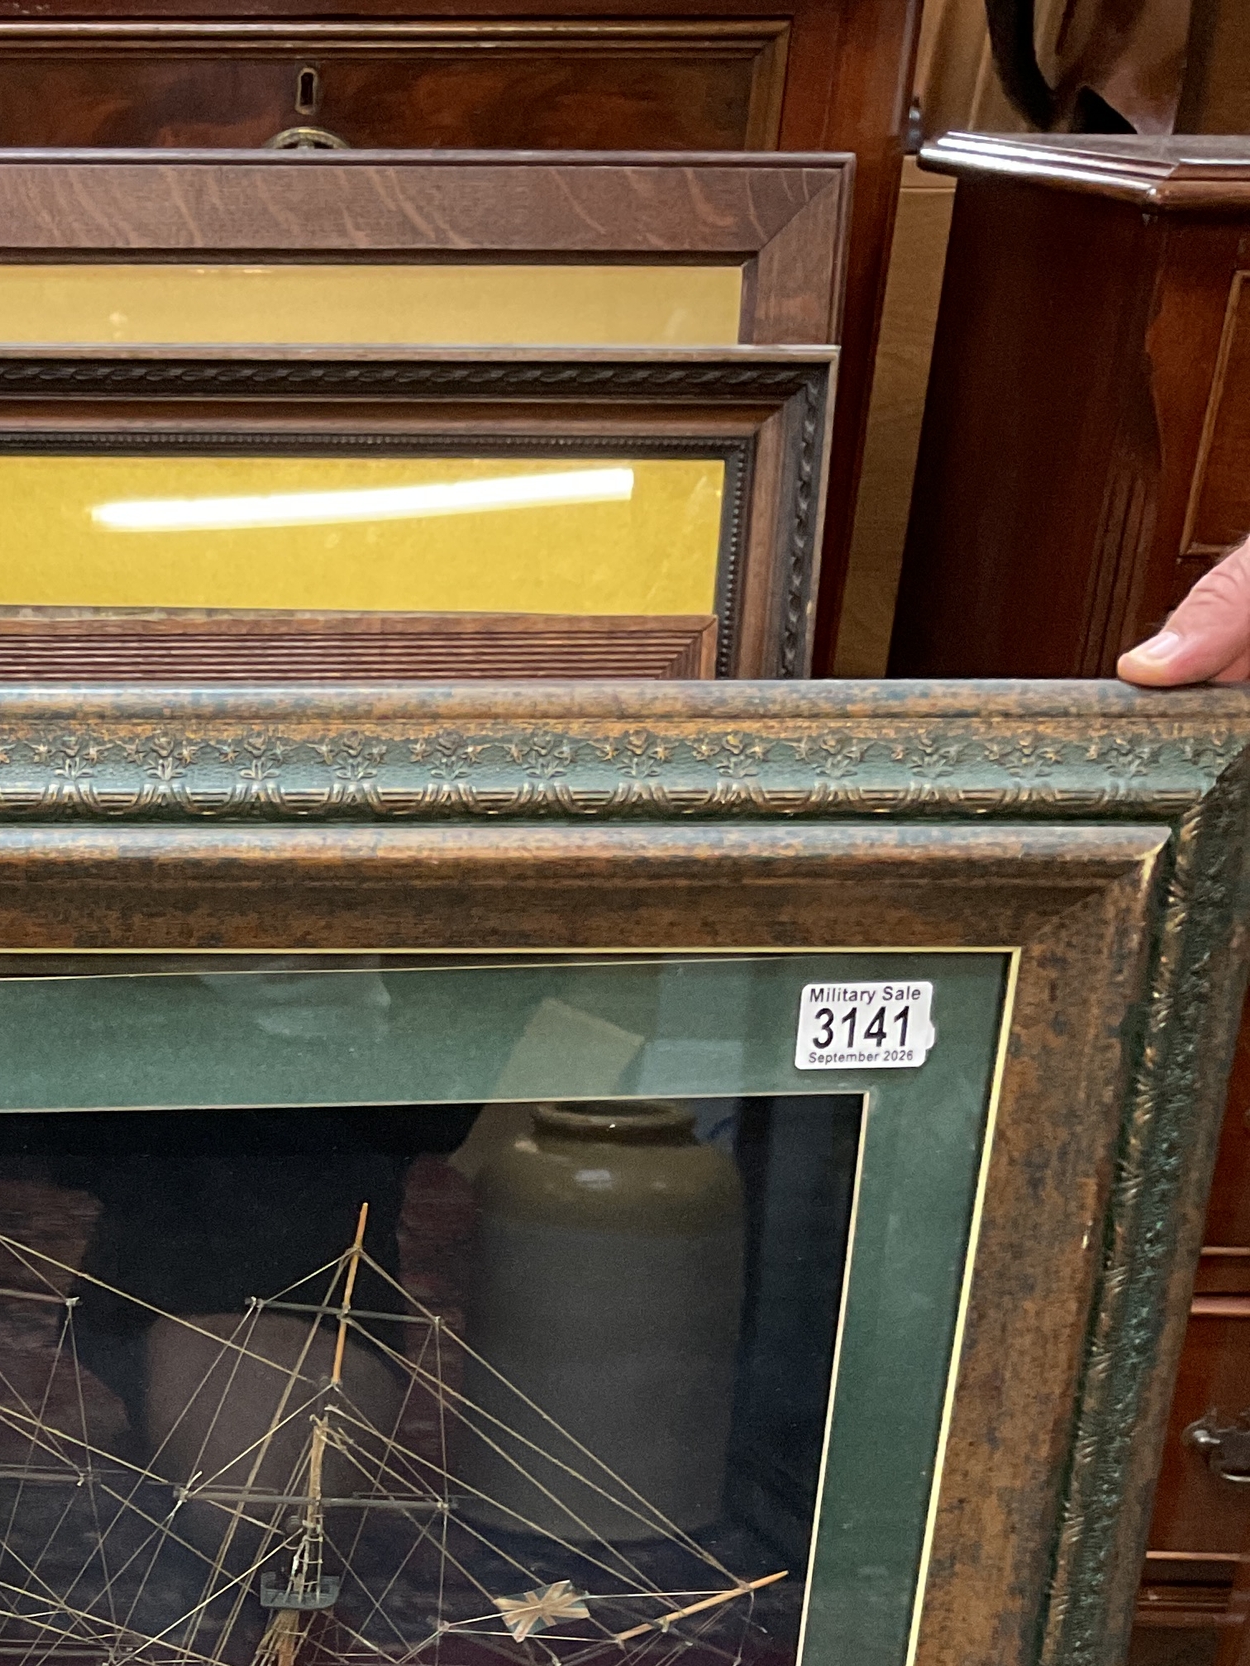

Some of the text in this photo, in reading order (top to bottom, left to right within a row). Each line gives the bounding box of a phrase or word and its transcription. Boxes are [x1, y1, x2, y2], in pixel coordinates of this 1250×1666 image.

[810, 986, 921, 1005] Military Sale
[812, 1005, 910, 1049] 3141
[808, 1050, 914, 1065] September 2026
